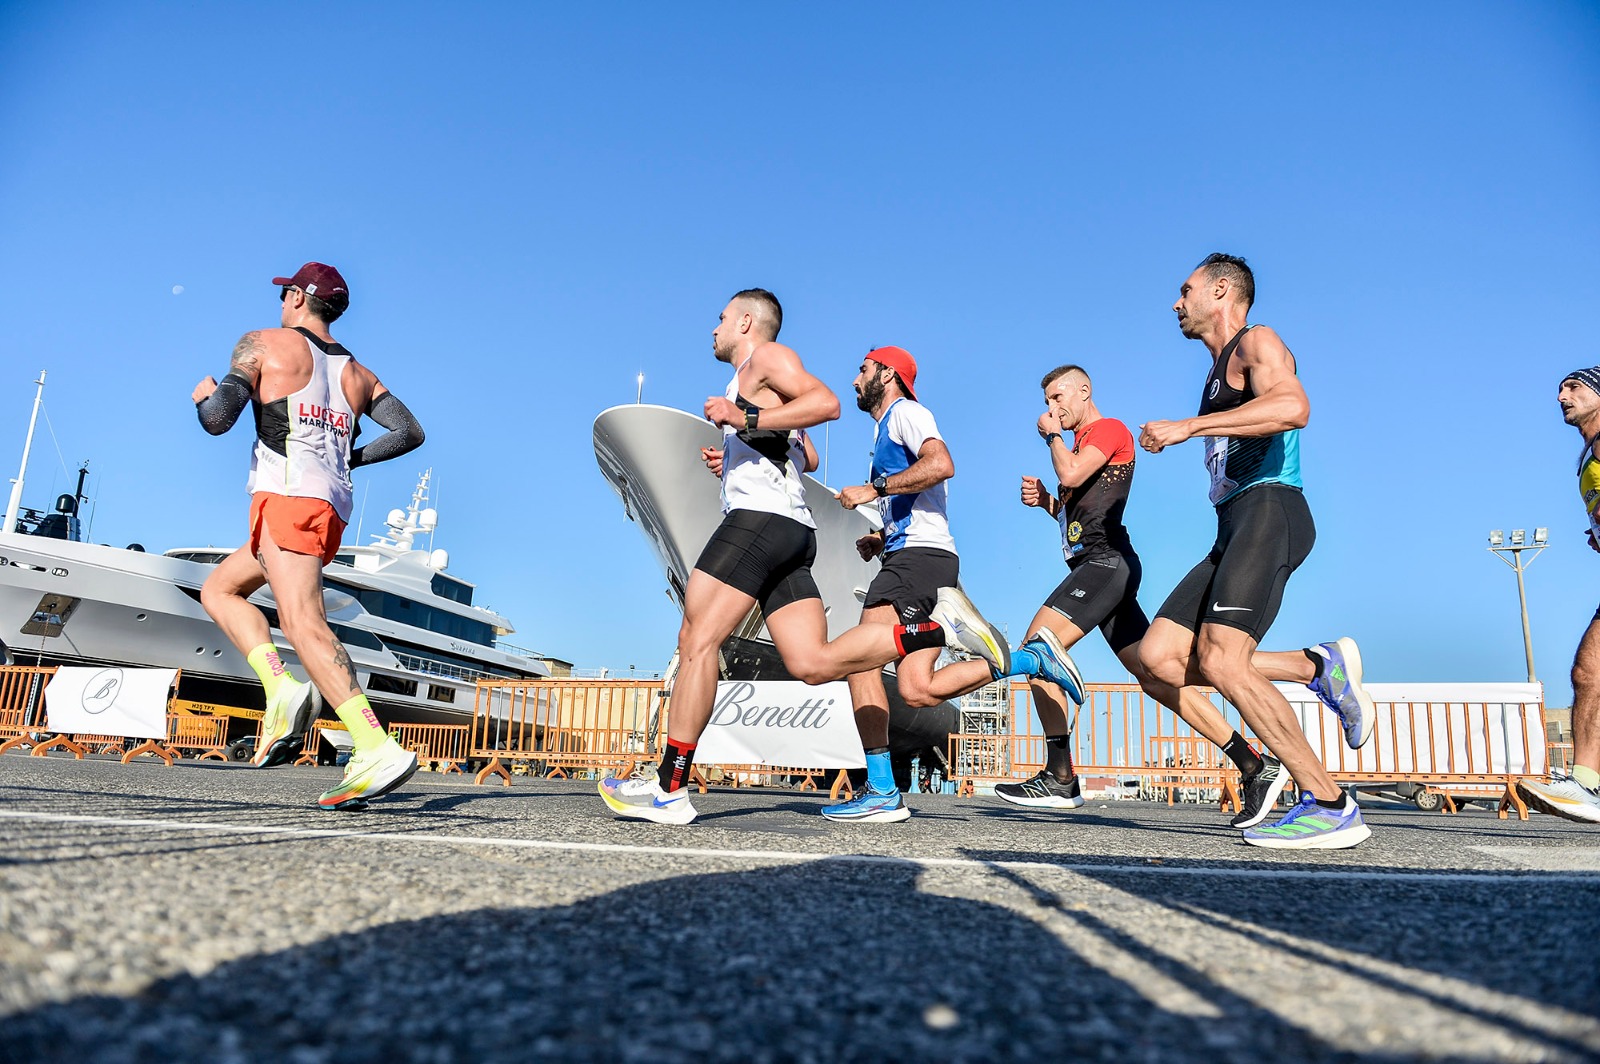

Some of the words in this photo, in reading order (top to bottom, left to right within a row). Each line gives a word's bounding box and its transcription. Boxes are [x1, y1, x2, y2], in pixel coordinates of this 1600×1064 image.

[299, 403, 345, 430] LUCCA
[299, 416, 345, 437] MARATHON
[265, 651, 285, 677] GOING
[708, 681, 835, 729] Benetti
[361, 708, 381, 729] KEEP
